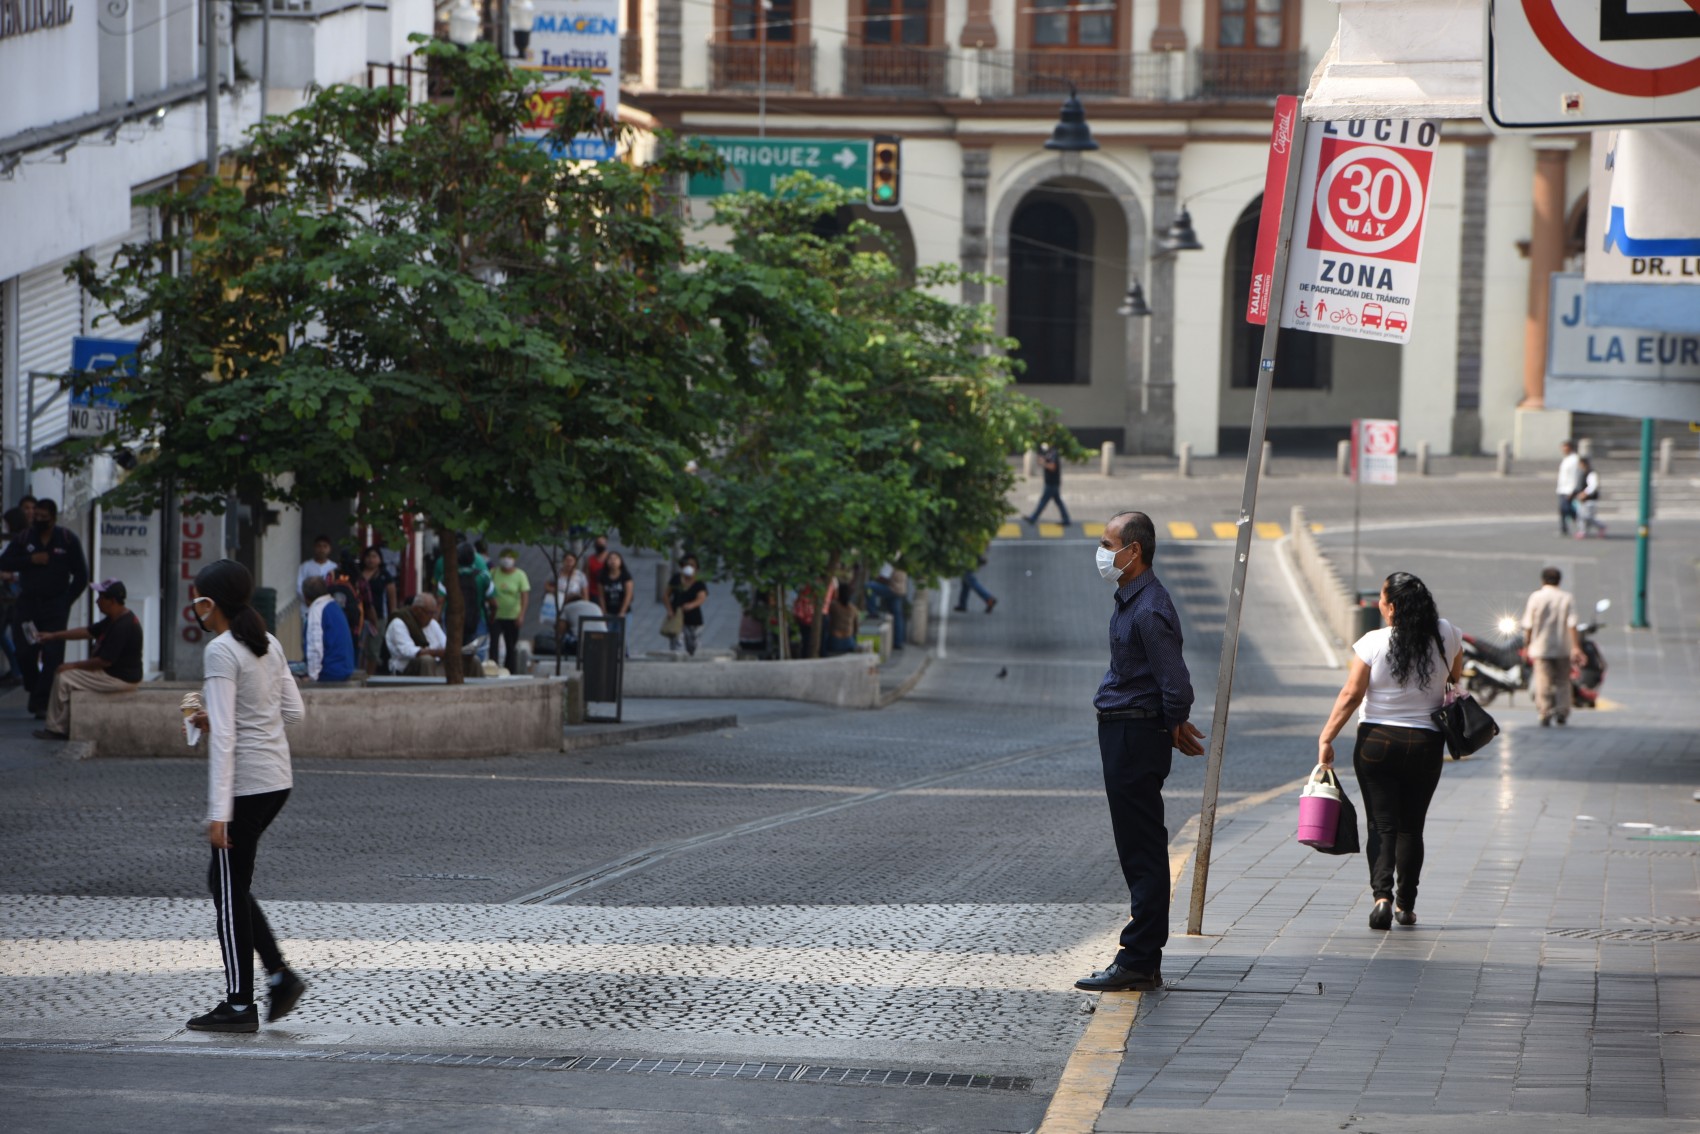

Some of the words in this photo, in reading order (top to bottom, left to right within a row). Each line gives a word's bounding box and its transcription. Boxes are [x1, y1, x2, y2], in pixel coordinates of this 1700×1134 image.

[716, 145, 821, 167] NRIQUEZ
[1338, 163, 1403, 221] 30
[1345, 218, 1387, 237] MÁX
[1320, 259, 1394, 291] ZONA
[1631, 257, 1672, 276] DR.
[1250, 273, 1263, 315] XALAPA
[1299, 283, 1310, 292] DE
[1310, 284, 1360, 298] PACIFICACIÓN
[1360, 291, 1375, 301] DEL
[1376, 293, 1411, 306] TRÁNSITO
[1587, 335, 1625, 363] LA
[71, 410, 89, 430] NO
